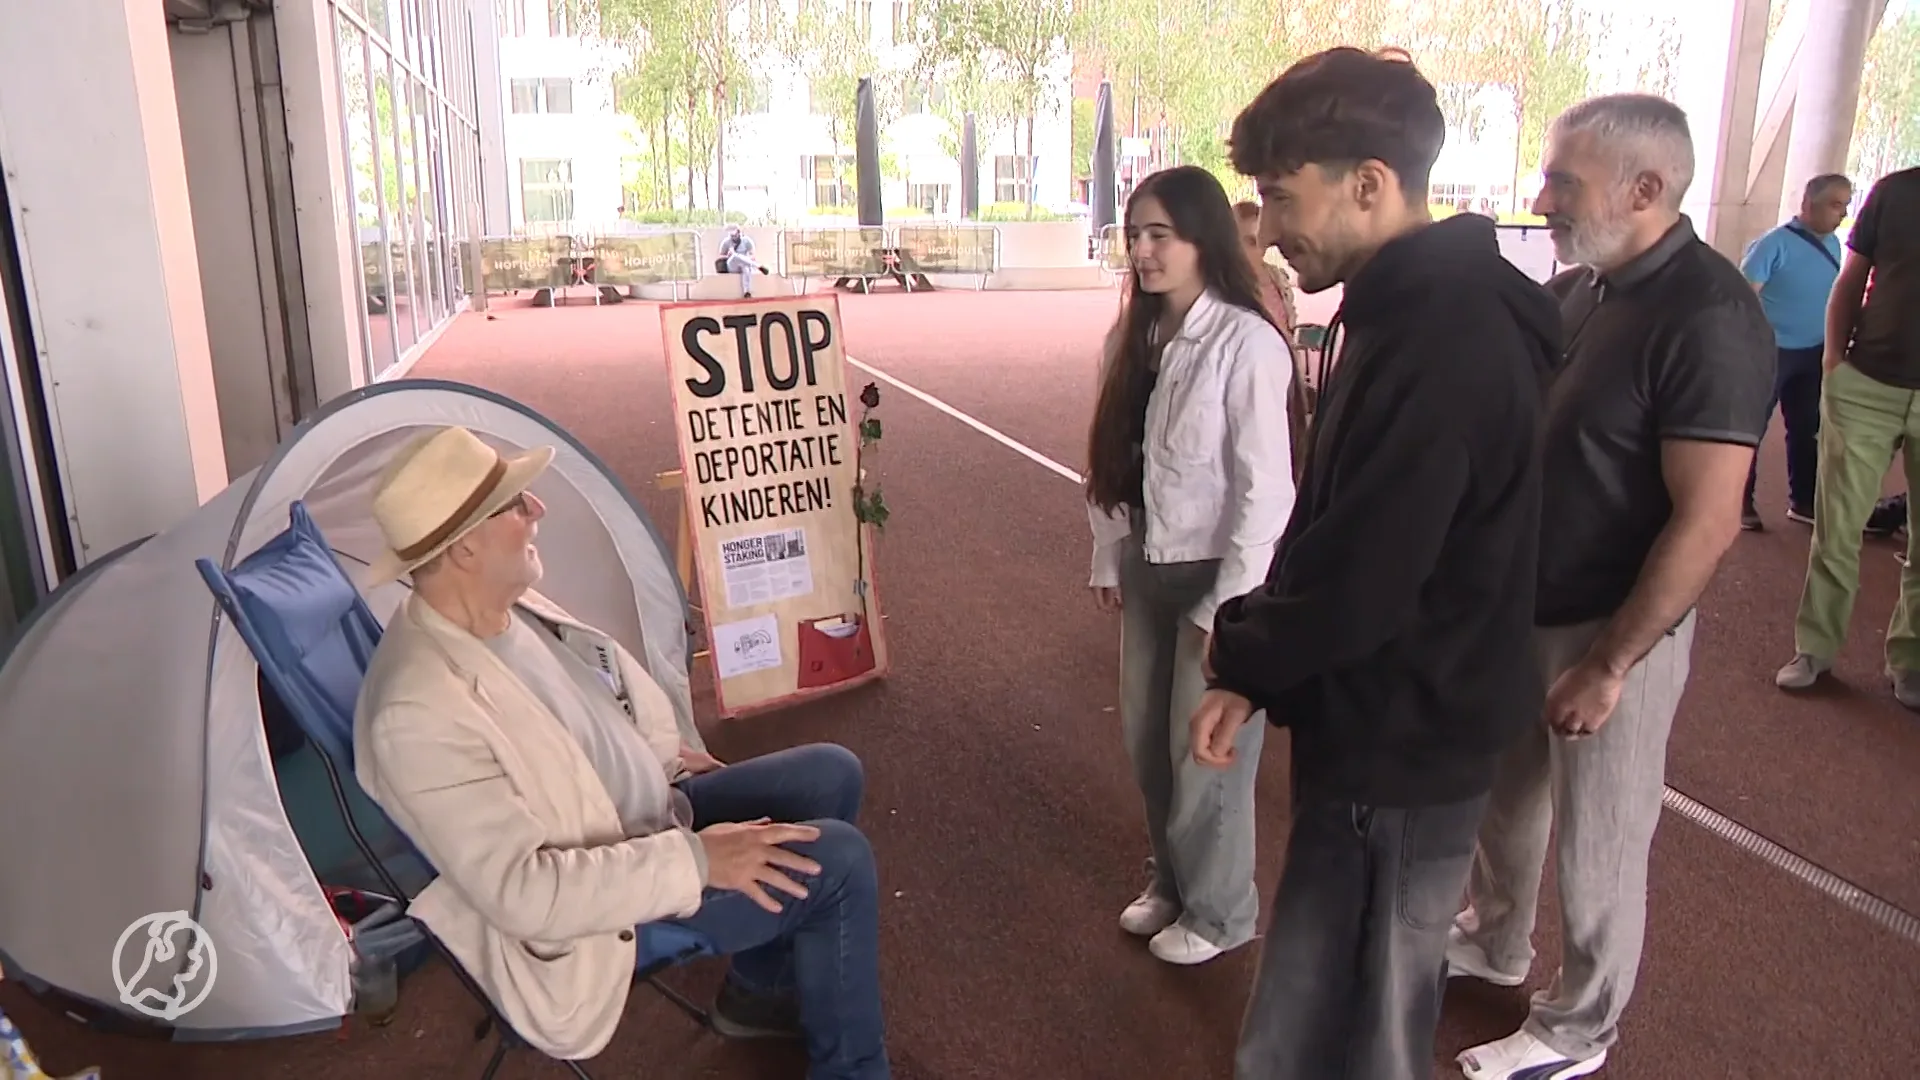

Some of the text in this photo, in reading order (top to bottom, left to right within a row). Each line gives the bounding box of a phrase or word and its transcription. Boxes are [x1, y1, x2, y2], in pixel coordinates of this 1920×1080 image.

[682, 310, 831, 398] STOP
[688, 393, 847, 443] DETENTIE EN
[694, 433, 842, 485] DEPORTATIE
[701, 477, 832, 528] KINDEREN!
[722, 537, 764, 553] HONGER
[723, 549, 765, 564] STAKING
